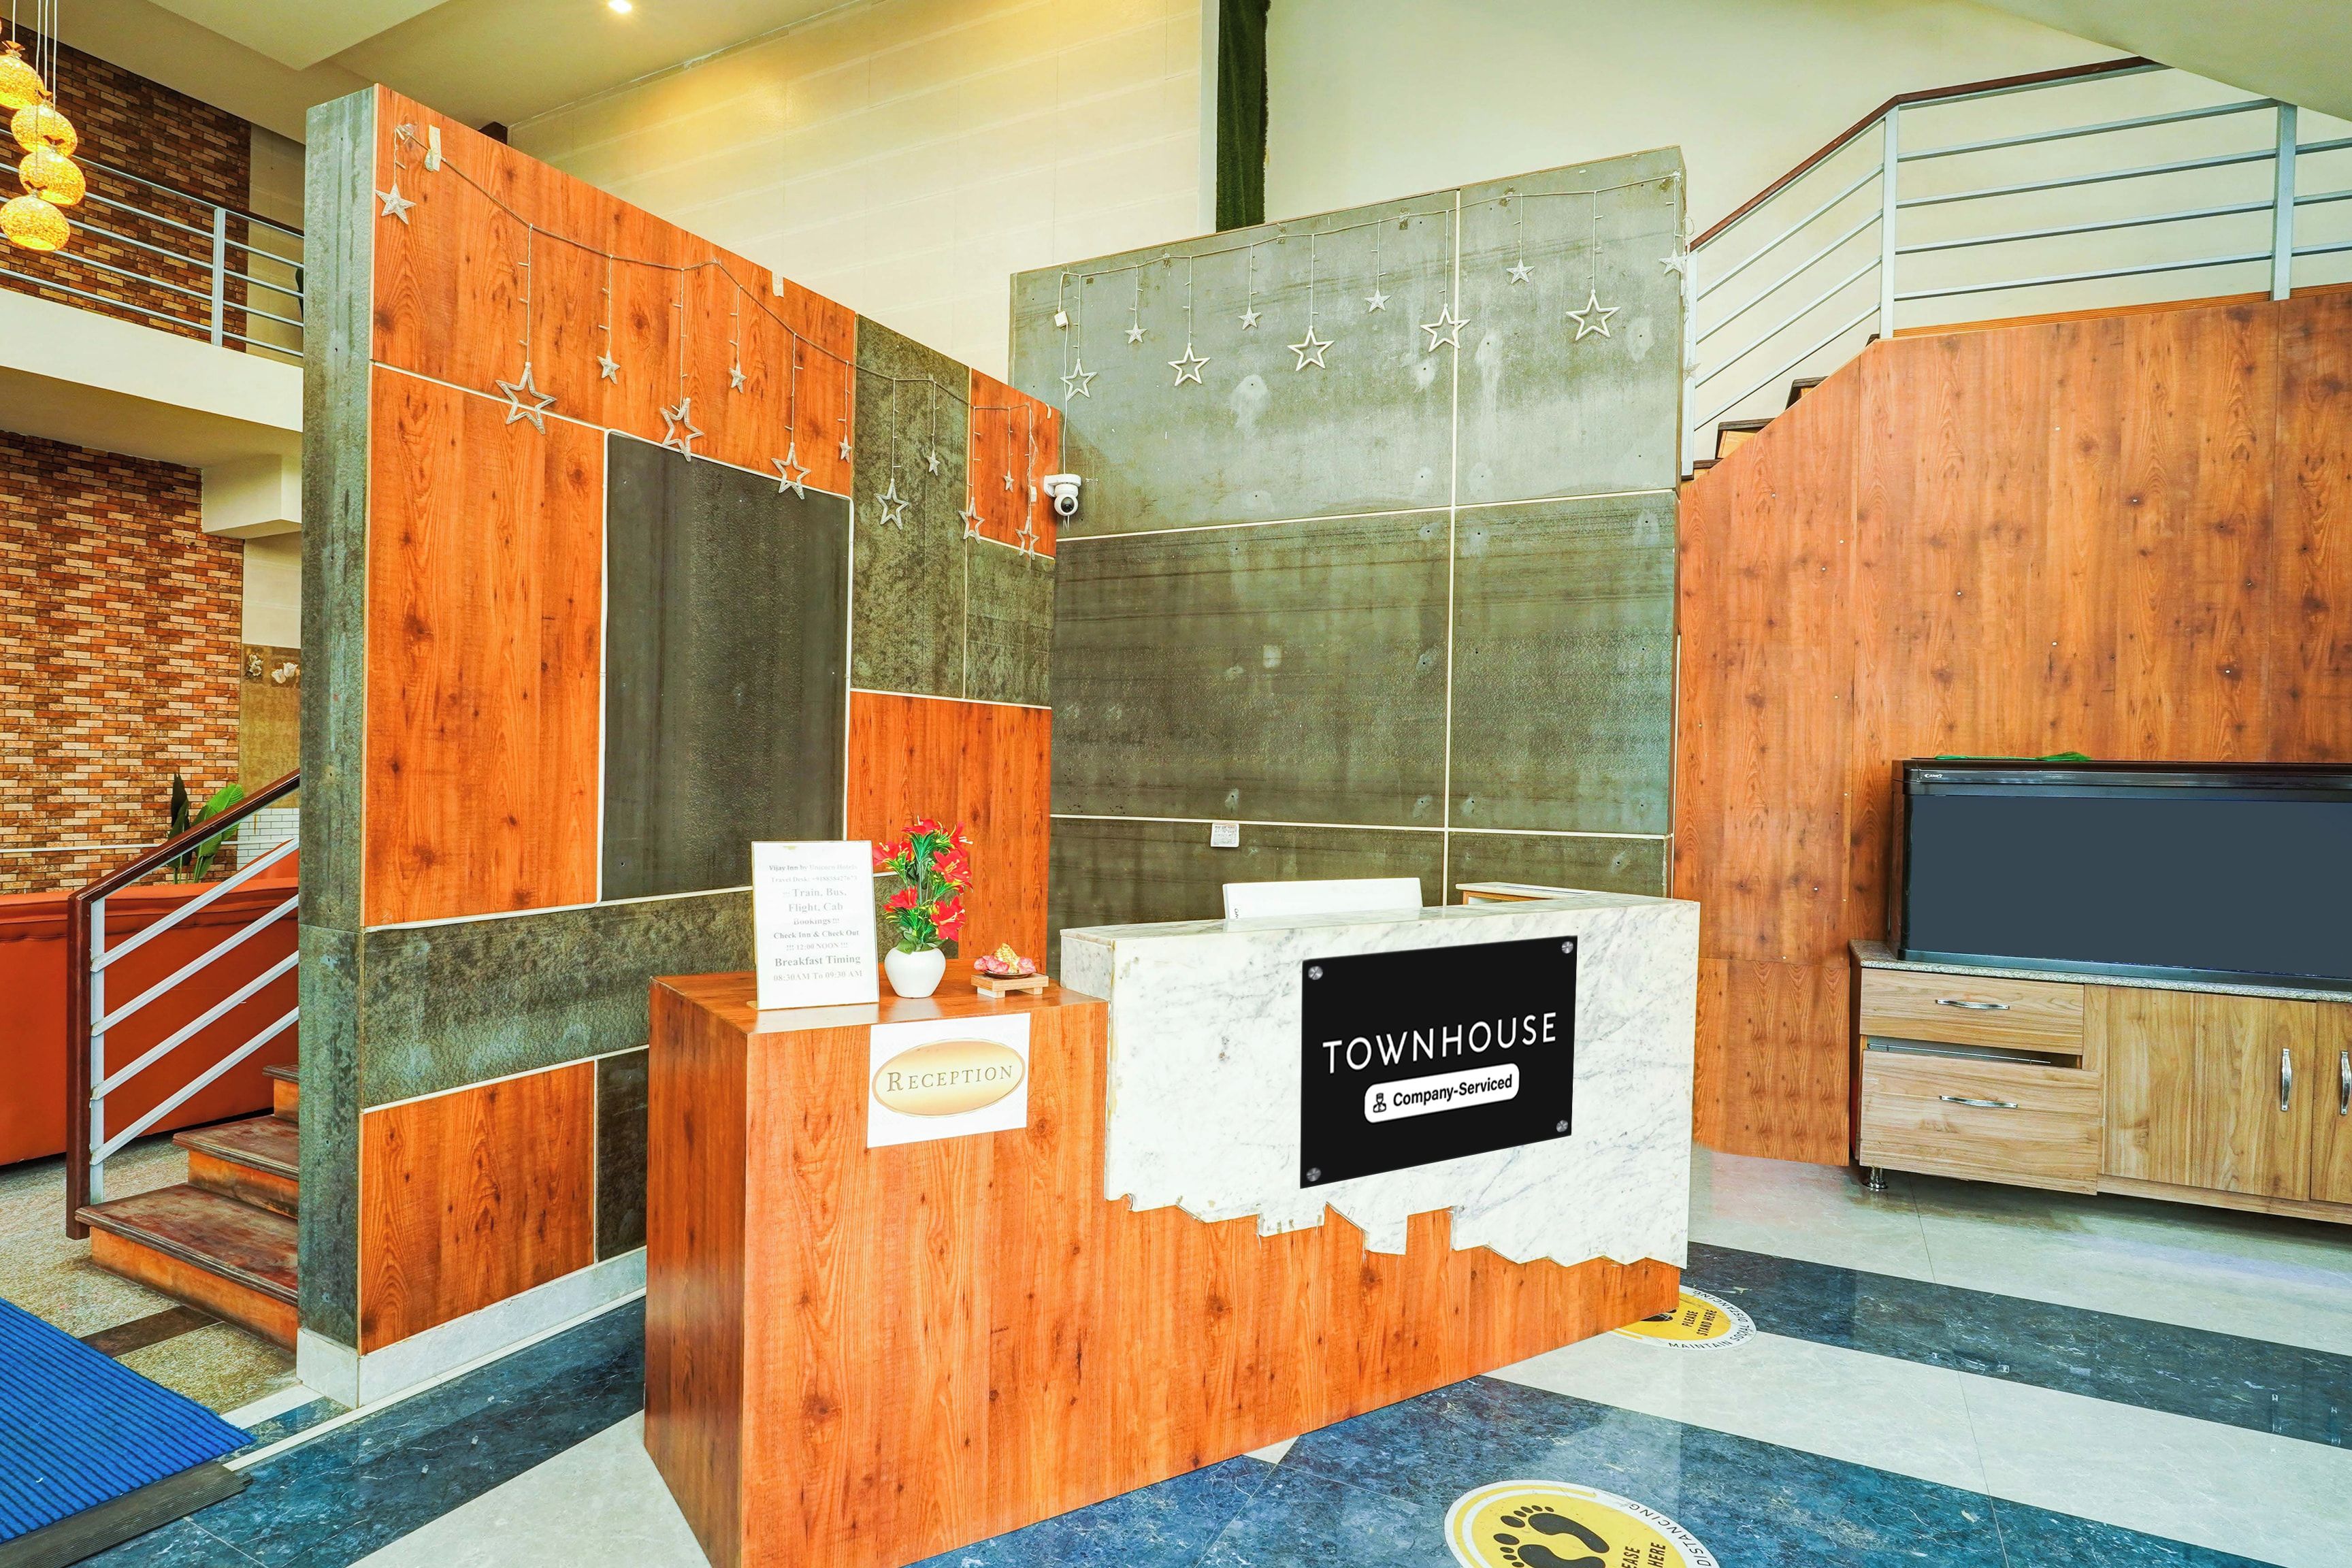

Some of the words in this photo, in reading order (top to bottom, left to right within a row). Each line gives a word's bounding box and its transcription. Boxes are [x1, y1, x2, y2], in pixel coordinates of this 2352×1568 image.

[768, 864, 785, 872] Vijay
[800, 864, 808, 872] by
[823, 902, 843, 911] Cab
[794, 917, 831, 926] Bookings
[796, 943, 815, 951] 12:00
[774, 956, 823, 967] Breakfast
[826, 955, 861, 965] Timing
[1322, 1012, 1557, 1075] TOWNHOUSE
[887, 1065, 1012, 1092] RECEPTION
[1393, 1074, 1513, 1107] Company-Serviced
[1693, 1290, 1748, 1322] DISTANCING
[1682, 1310, 1699, 1327] PLEASE
[1703, 1309, 1718, 1322] HERE
[1696, 1321, 1712, 1337] STAND
[1729, 1324, 1751, 1341] SOCIAL
[1668, 1340, 1733, 1349] MAINTAIN
[1629, 1503, 1712, 1567] DISTANCING
[1621, 1546, 1641, 1568] EASE
[1647, 1542, 1666, 1568] HERE
